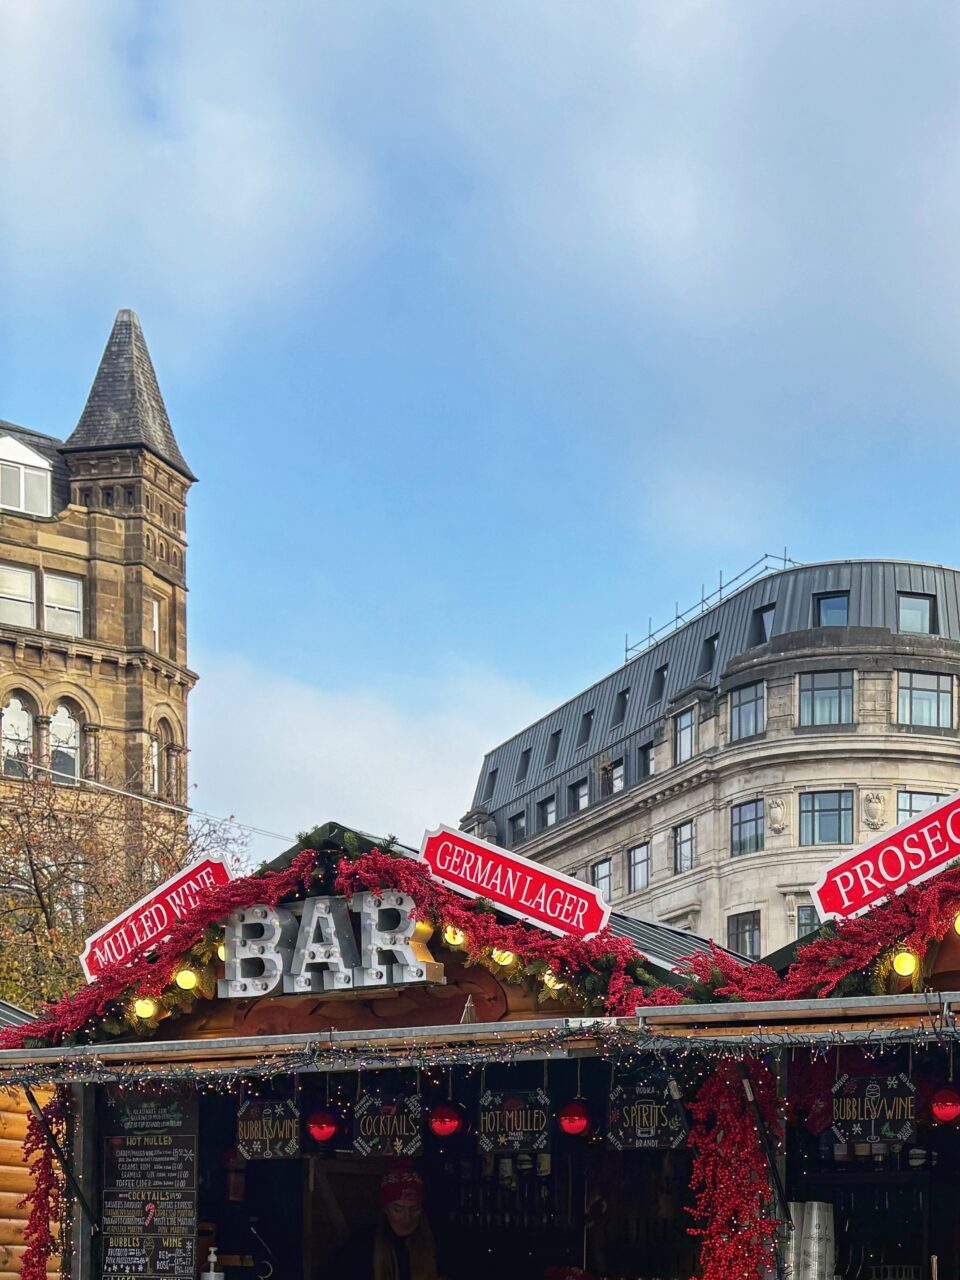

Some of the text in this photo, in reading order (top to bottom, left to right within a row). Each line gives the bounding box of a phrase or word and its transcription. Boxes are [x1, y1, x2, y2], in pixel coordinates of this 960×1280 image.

[436, 841, 589, 930] GERMAN LAGER
[93, 867, 219, 968] MULLED WINE
[217, 889, 446, 999] BAR
[609, 1085, 624, 1101] RUM
[360, 1114, 416, 1136] COCKTAILS
[480, 1109, 547, 1132] HOT MULLED
[622, 1105, 668, 1128] SPIRITS
[128, 1191, 169, 1200] COCKTAILS
[109, 1237, 140, 1248] BUBBLES
[162, 1237, 182, 1248] WINE
